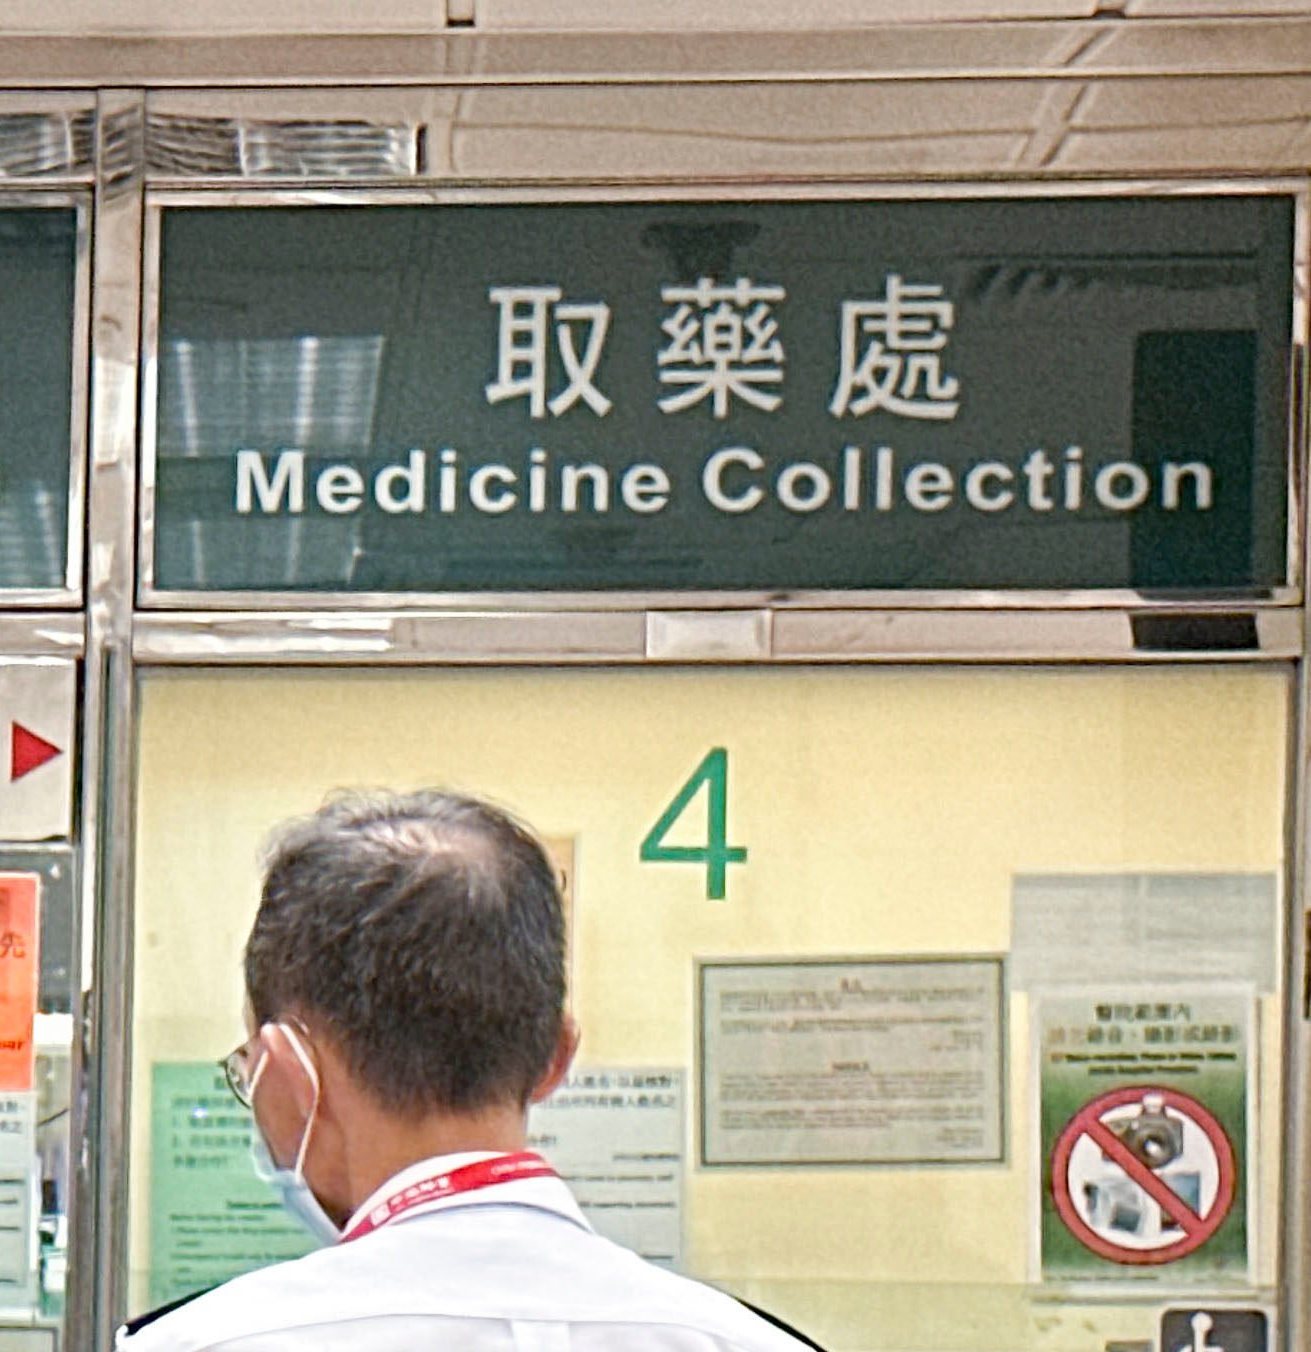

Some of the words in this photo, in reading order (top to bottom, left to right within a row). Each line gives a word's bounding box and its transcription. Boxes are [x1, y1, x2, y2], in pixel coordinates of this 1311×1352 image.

[485, 275, 958, 418] 取藥處
[237, 449, 669, 513] Medicine
[703, 446, 1218, 514] Collection
[638, 746, 750, 900] 4
